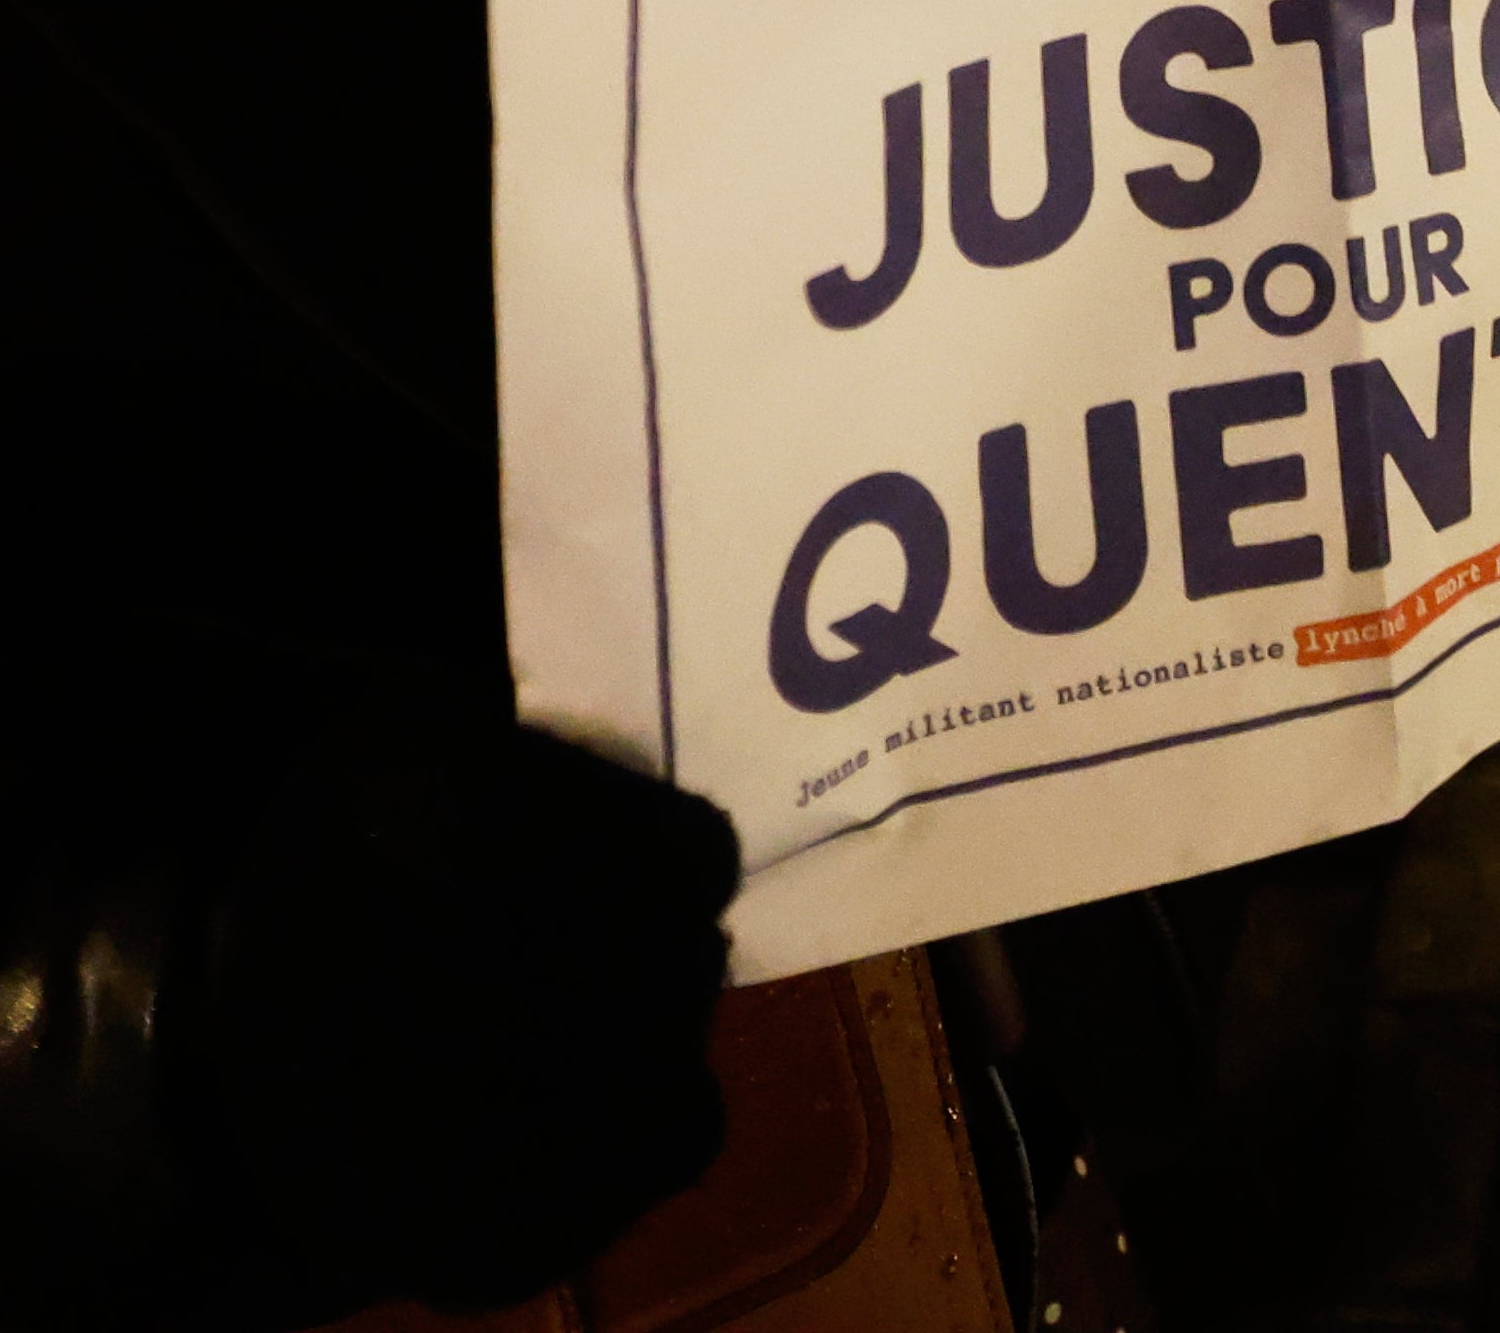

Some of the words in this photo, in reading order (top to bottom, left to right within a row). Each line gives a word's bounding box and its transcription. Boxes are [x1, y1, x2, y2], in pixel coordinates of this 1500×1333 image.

[1167, 211, 1470, 351] POUR
[884, 691, 1036, 753] militant
[1056, 639, 1285, 707] nationaliste
[1304, 609, 1406, 654] lynché
[1416, 591, 1428, 619] à
[1434, 563, 1482, 602] mort
